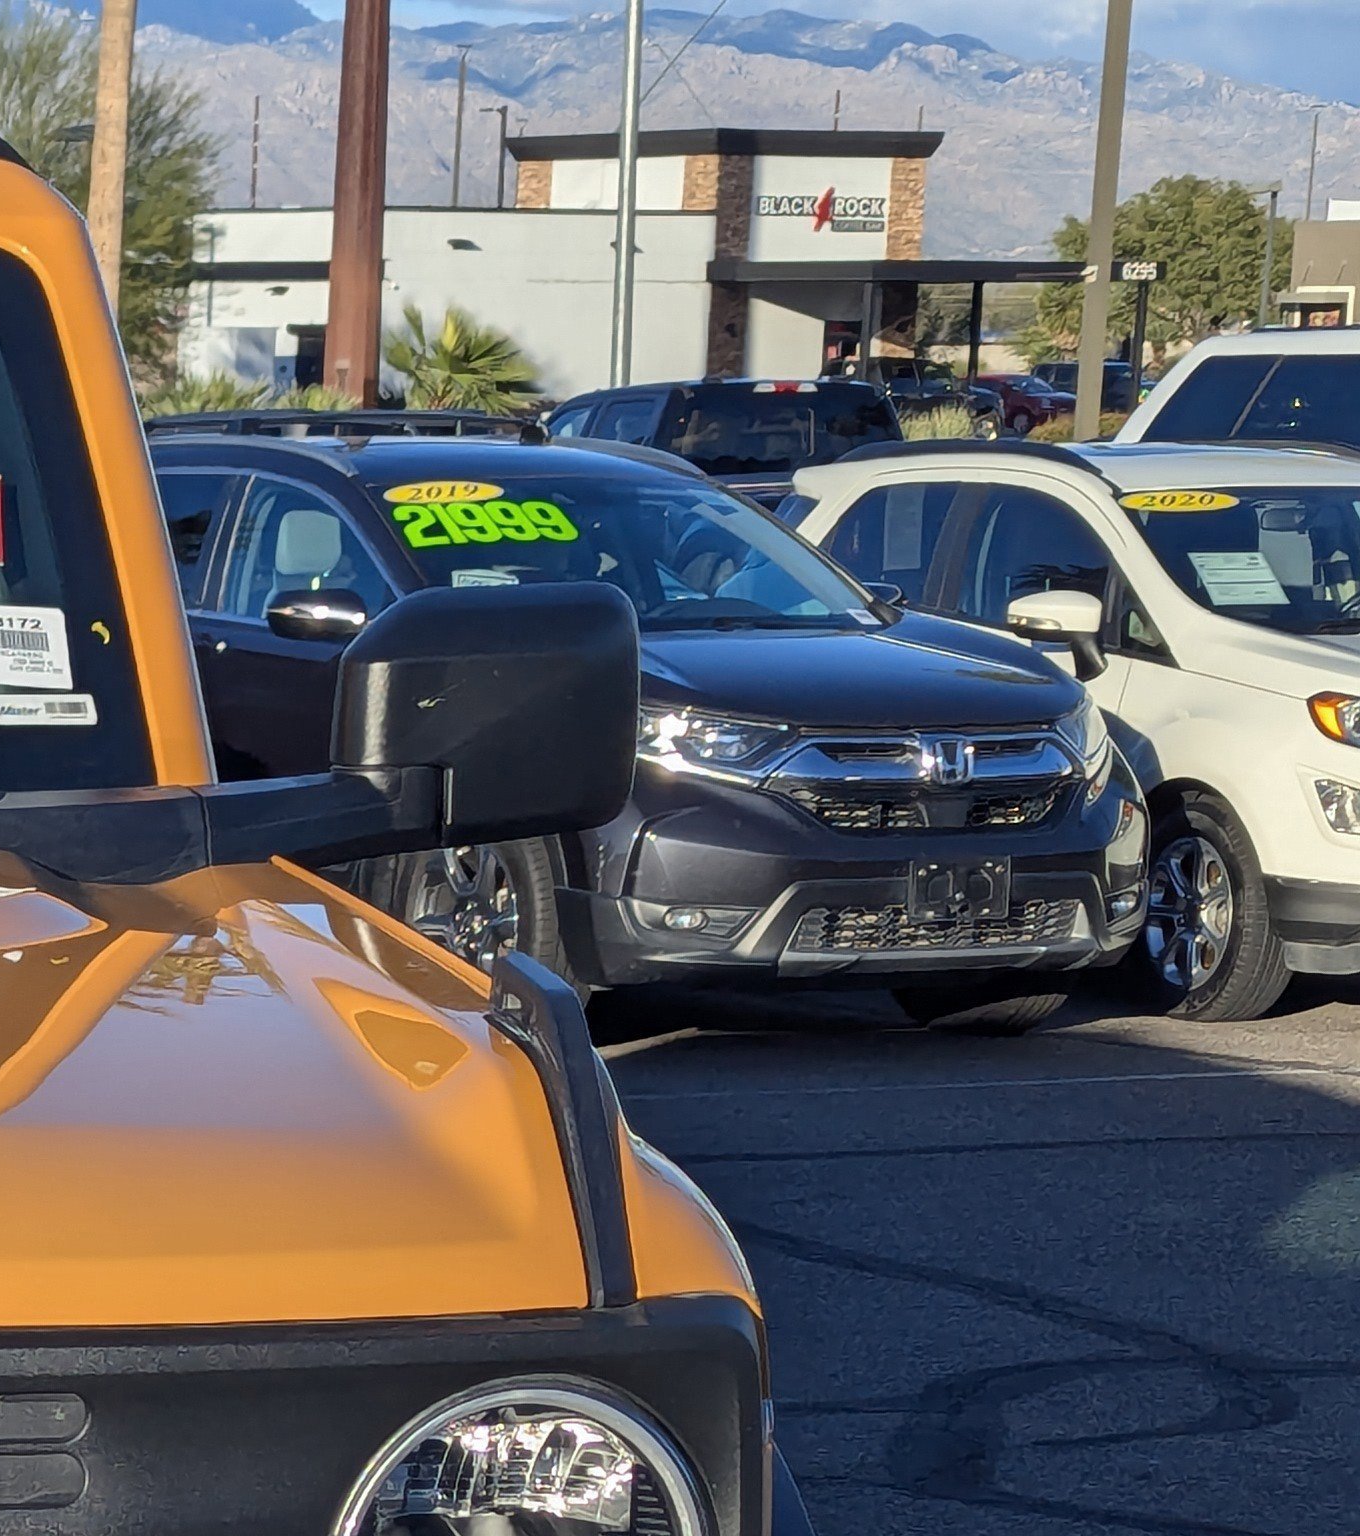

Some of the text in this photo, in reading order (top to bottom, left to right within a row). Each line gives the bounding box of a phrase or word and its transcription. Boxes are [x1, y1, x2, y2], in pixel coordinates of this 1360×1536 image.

[758, 197, 884, 216] BLACK ROCK
[409, 484, 479, 501] 2019
[1141, 493, 1216, 508] 2020
[392, 500, 579, 548] 21999
